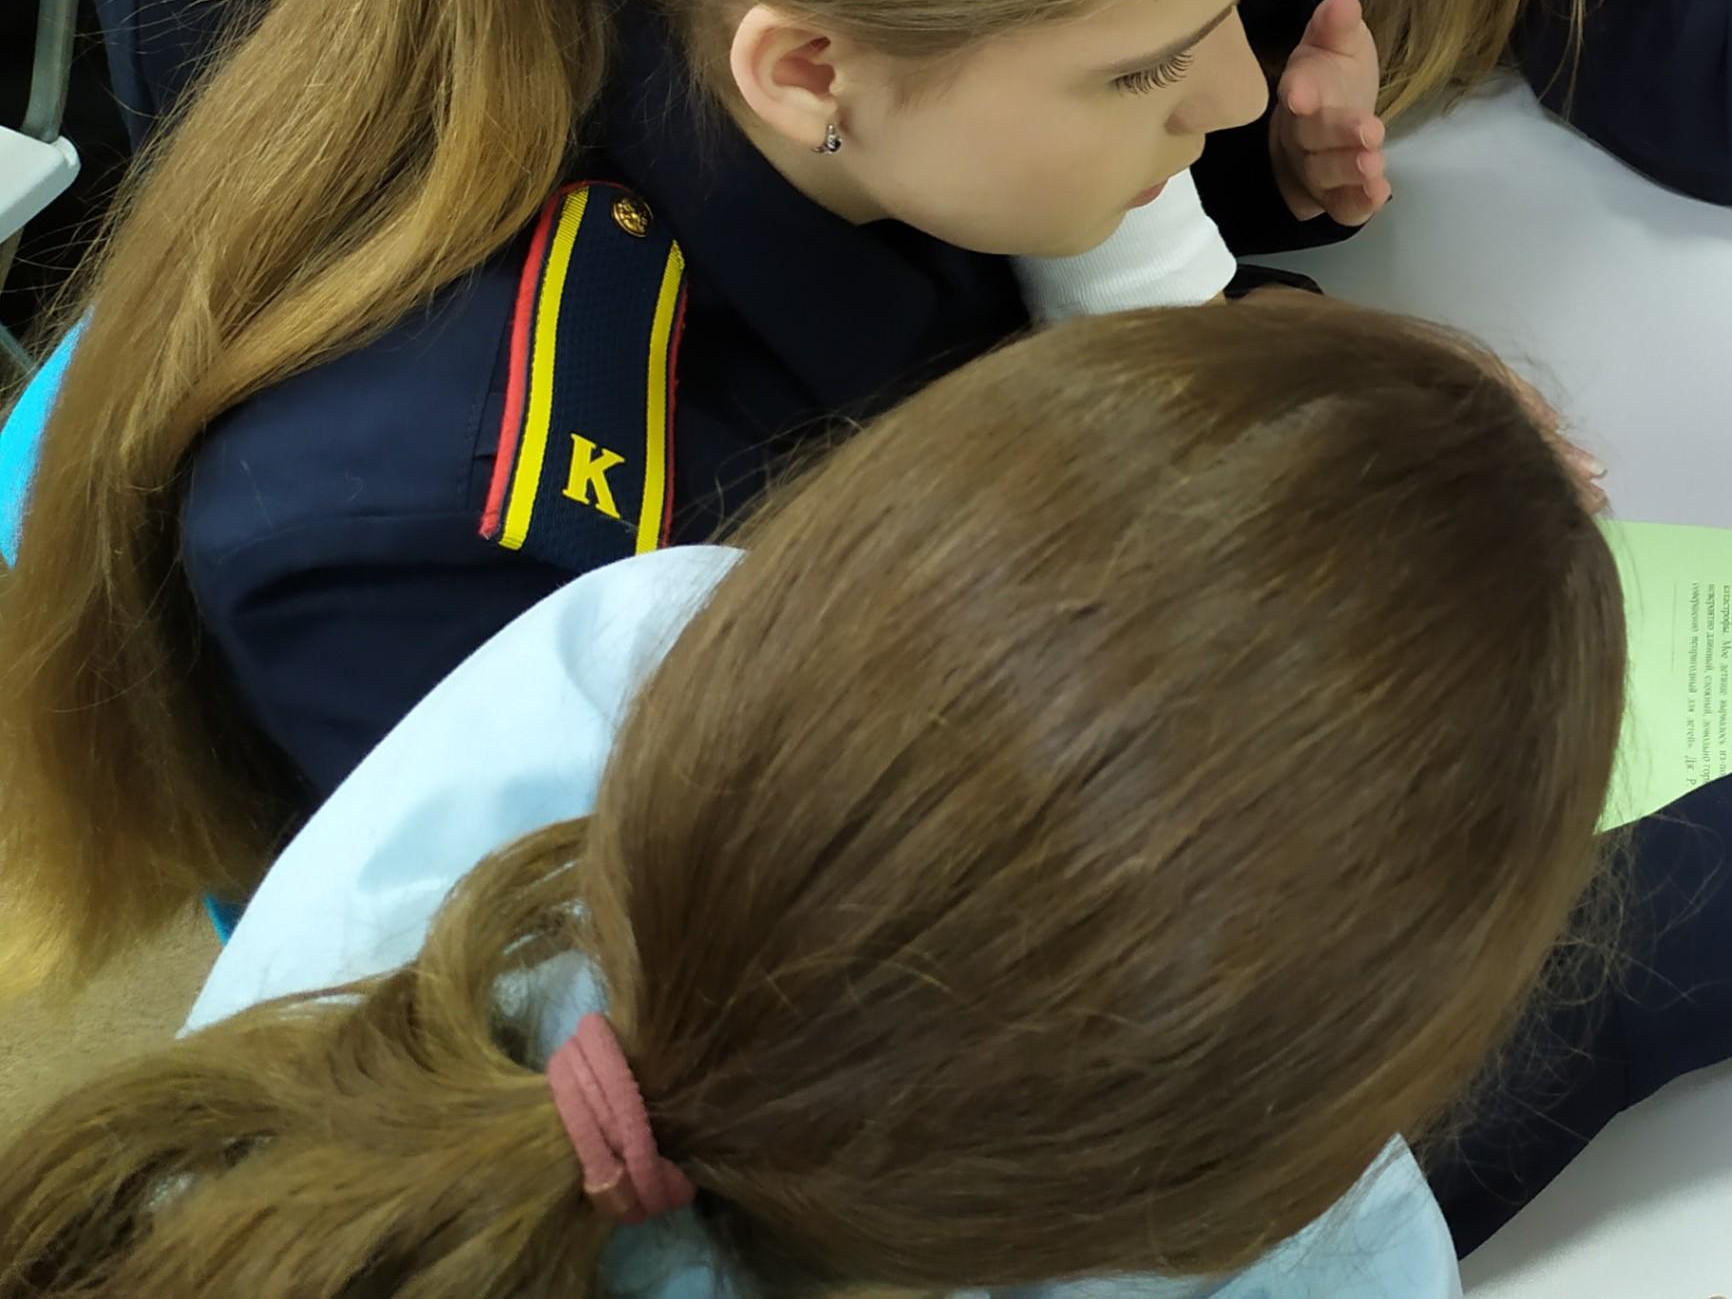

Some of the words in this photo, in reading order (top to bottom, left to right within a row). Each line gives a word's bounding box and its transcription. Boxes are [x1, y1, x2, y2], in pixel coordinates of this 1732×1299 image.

[562, 433, 625, 519] К
[1691, 582, 1699, 632] совершенно
[1706, 583, 1715, 631] невероятно
[1721, 584, 1731, 634] катастрофы.
[1687, 635, 1697, 693] непригодный
[1704, 631, 1714, 672] длинный,
[1703, 675, 1712, 716] сложный,
[1719, 663, 1727, 696] детище
[1687, 697, 1695, 712] для
[1718, 699, 1726, 745] вырвалось
[1701, 719, 1710, 761] довольно
